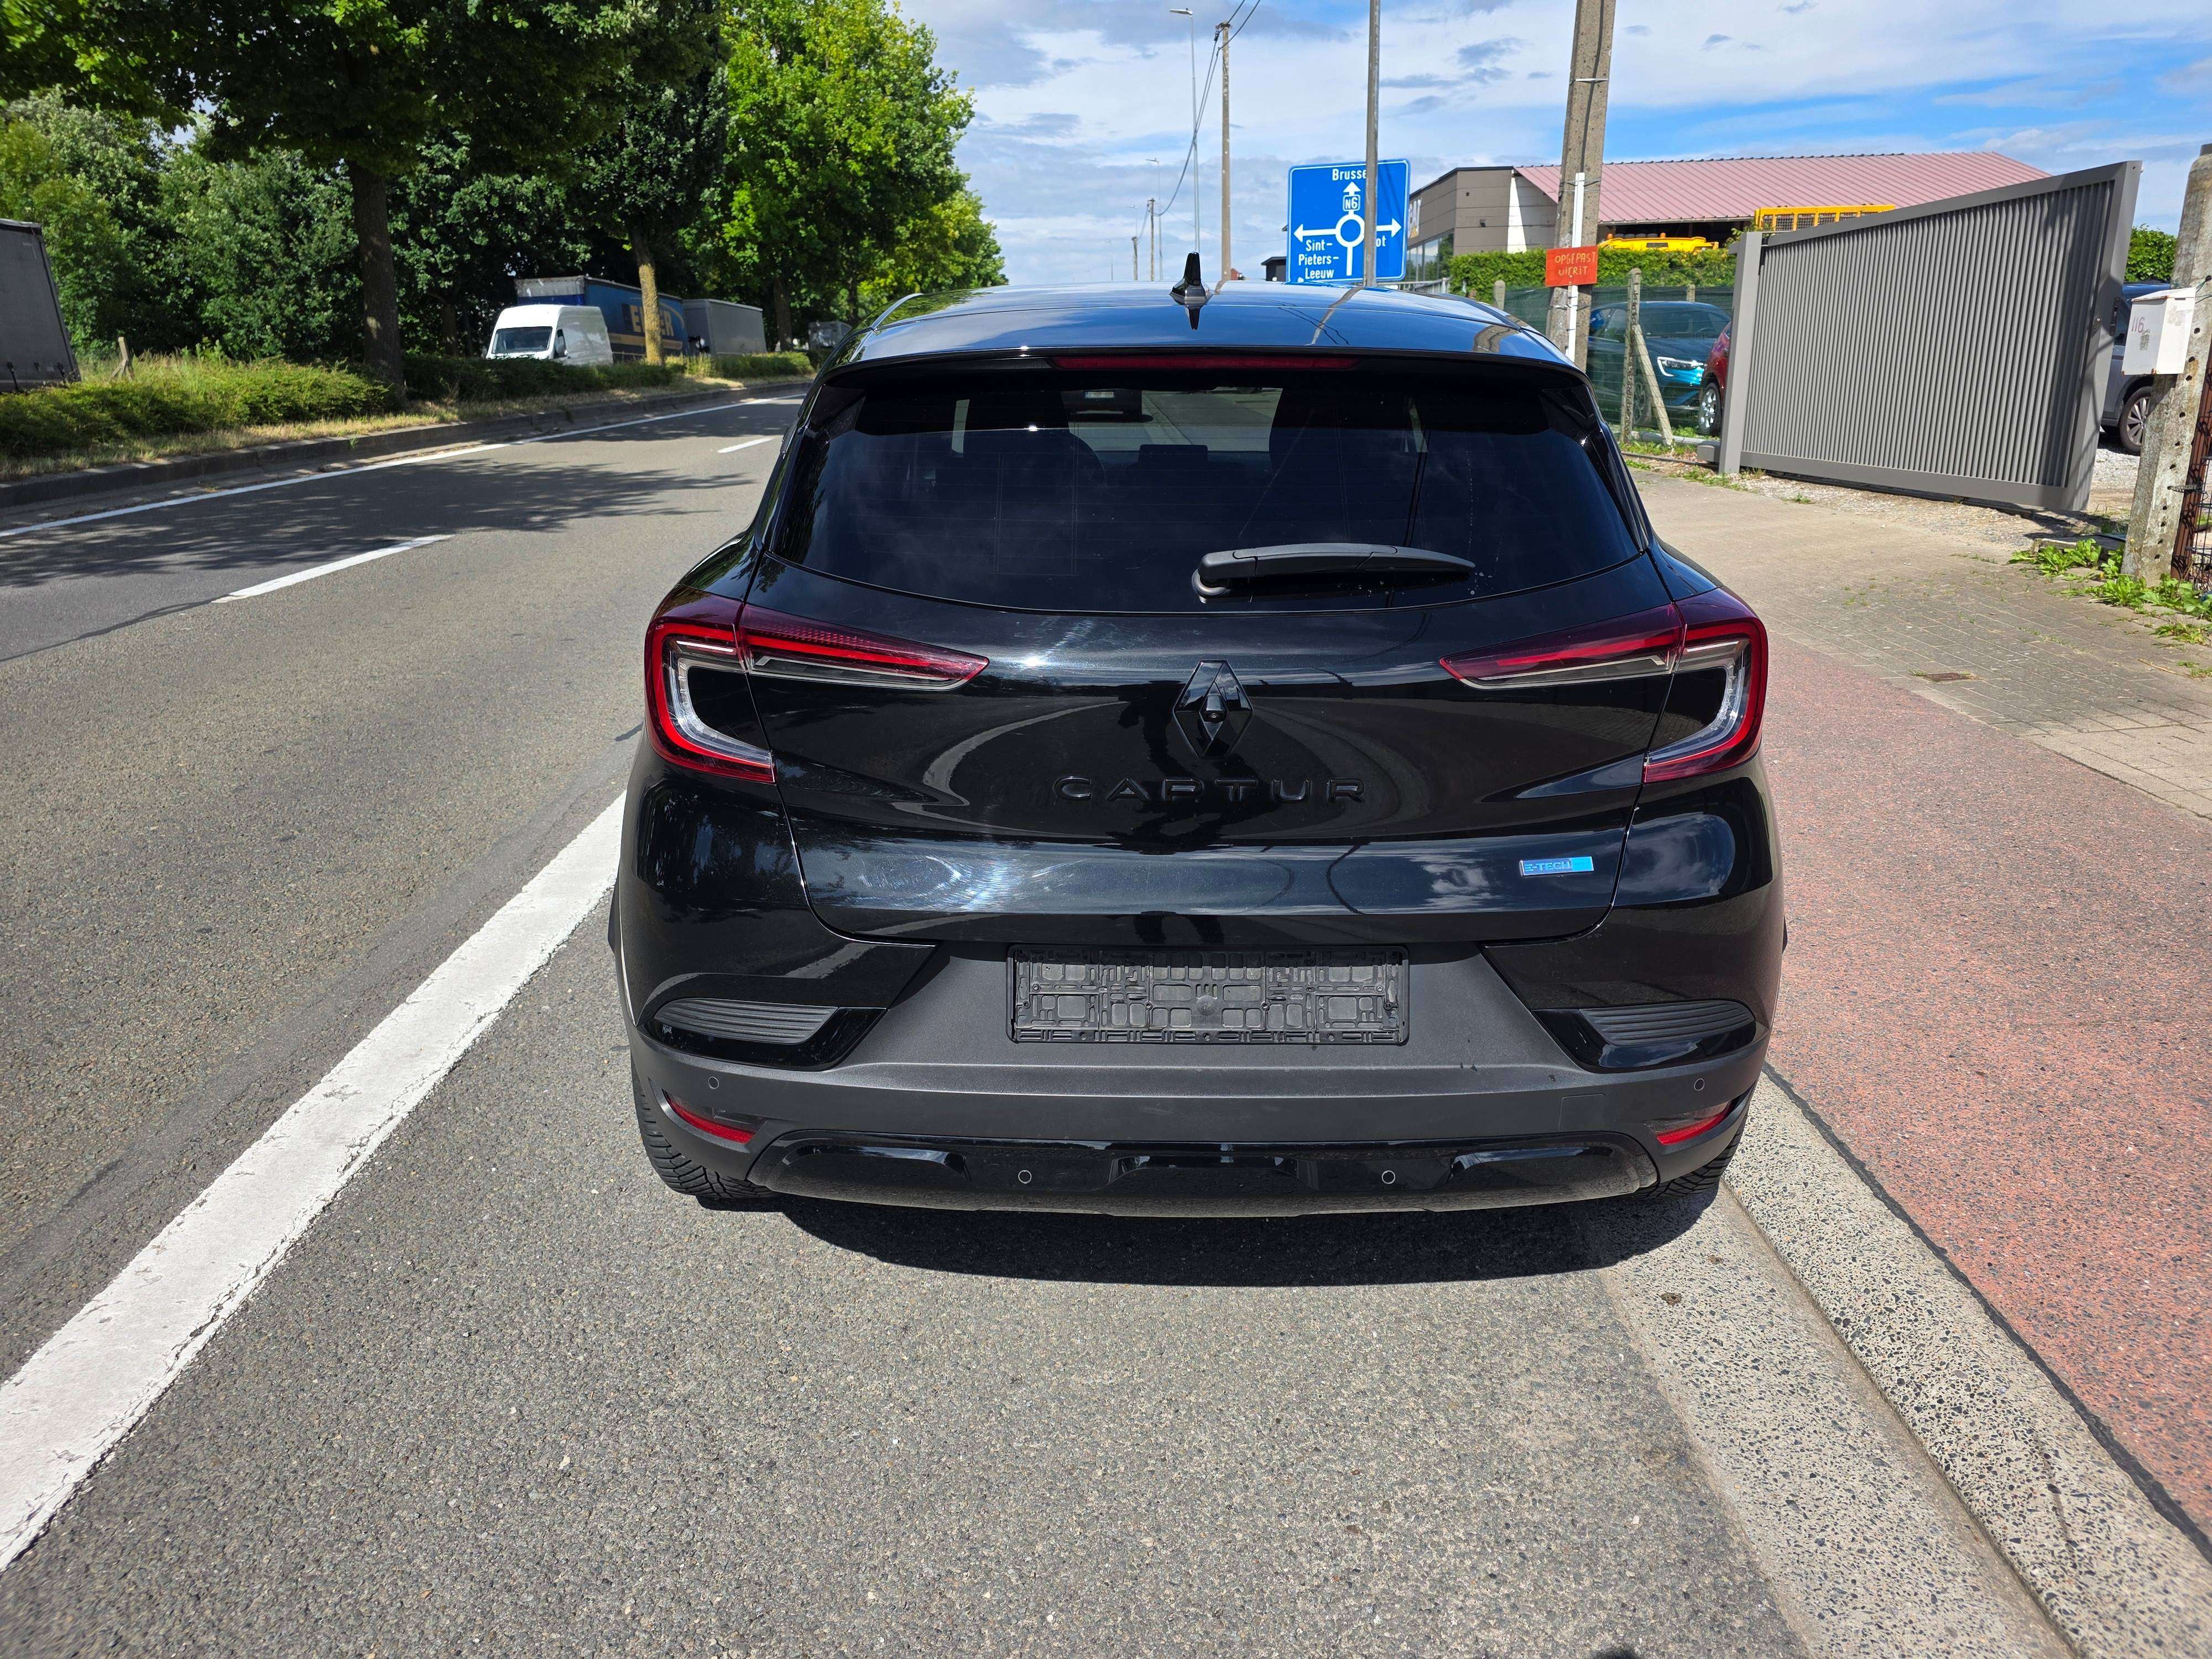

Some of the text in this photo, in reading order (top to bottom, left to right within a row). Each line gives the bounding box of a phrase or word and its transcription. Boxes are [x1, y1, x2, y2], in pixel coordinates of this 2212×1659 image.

[1332, 168, 1366, 181] Brusse
[1345, 197, 1358, 210] N6
[1305, 239, 1333, 252] Sint-
[1298, 253, 1339, 266] Pieters-
[1554, 252, 1597, 264] OPGEPAST
[1305, 267, 1334, 280] Leeuw
[2131, 317, 2145, 333] 116
[1052, 776, 1366, 802] CAPTUR
[1524, 861, 1571, 872] E-TECH
